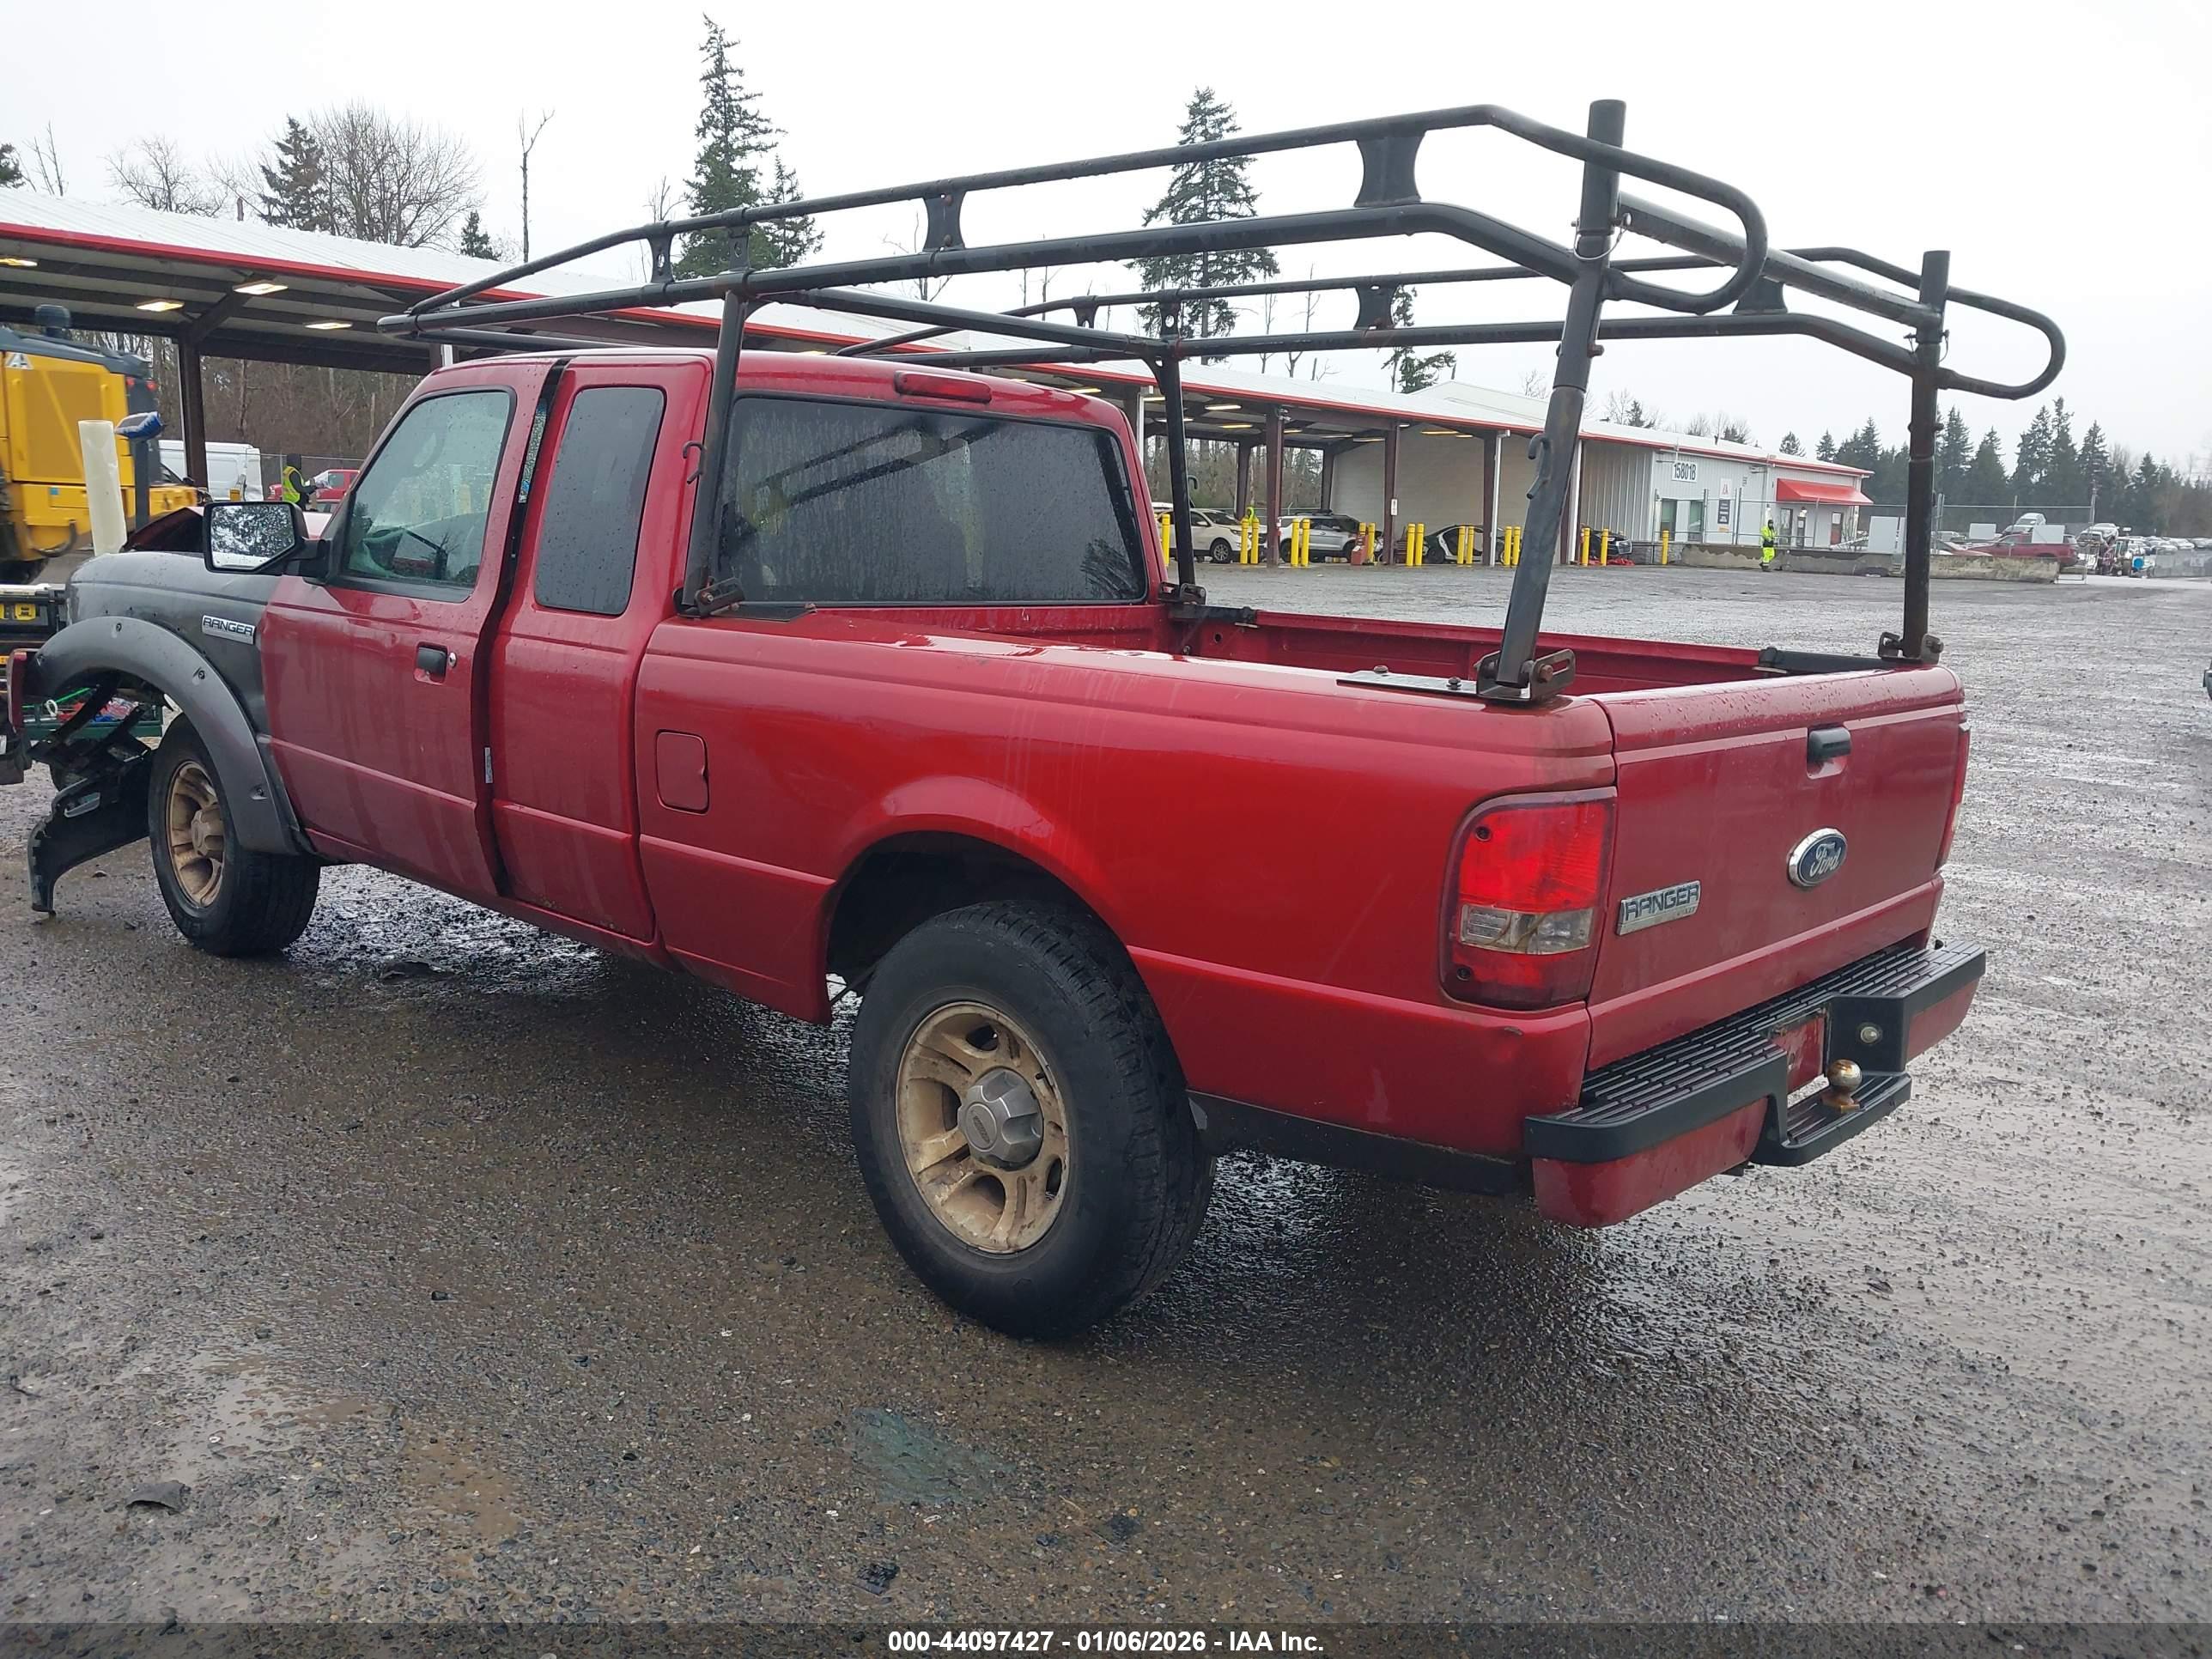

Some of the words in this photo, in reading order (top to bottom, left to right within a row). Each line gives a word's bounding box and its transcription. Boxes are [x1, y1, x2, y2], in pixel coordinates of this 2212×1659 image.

[1674, 462, 1697, 480] 15801B
[203, 617, 253, 636] RANGER
[1809, 842, 1842, 877] Ford
[1625, 884, 1699, 921] RANGER
